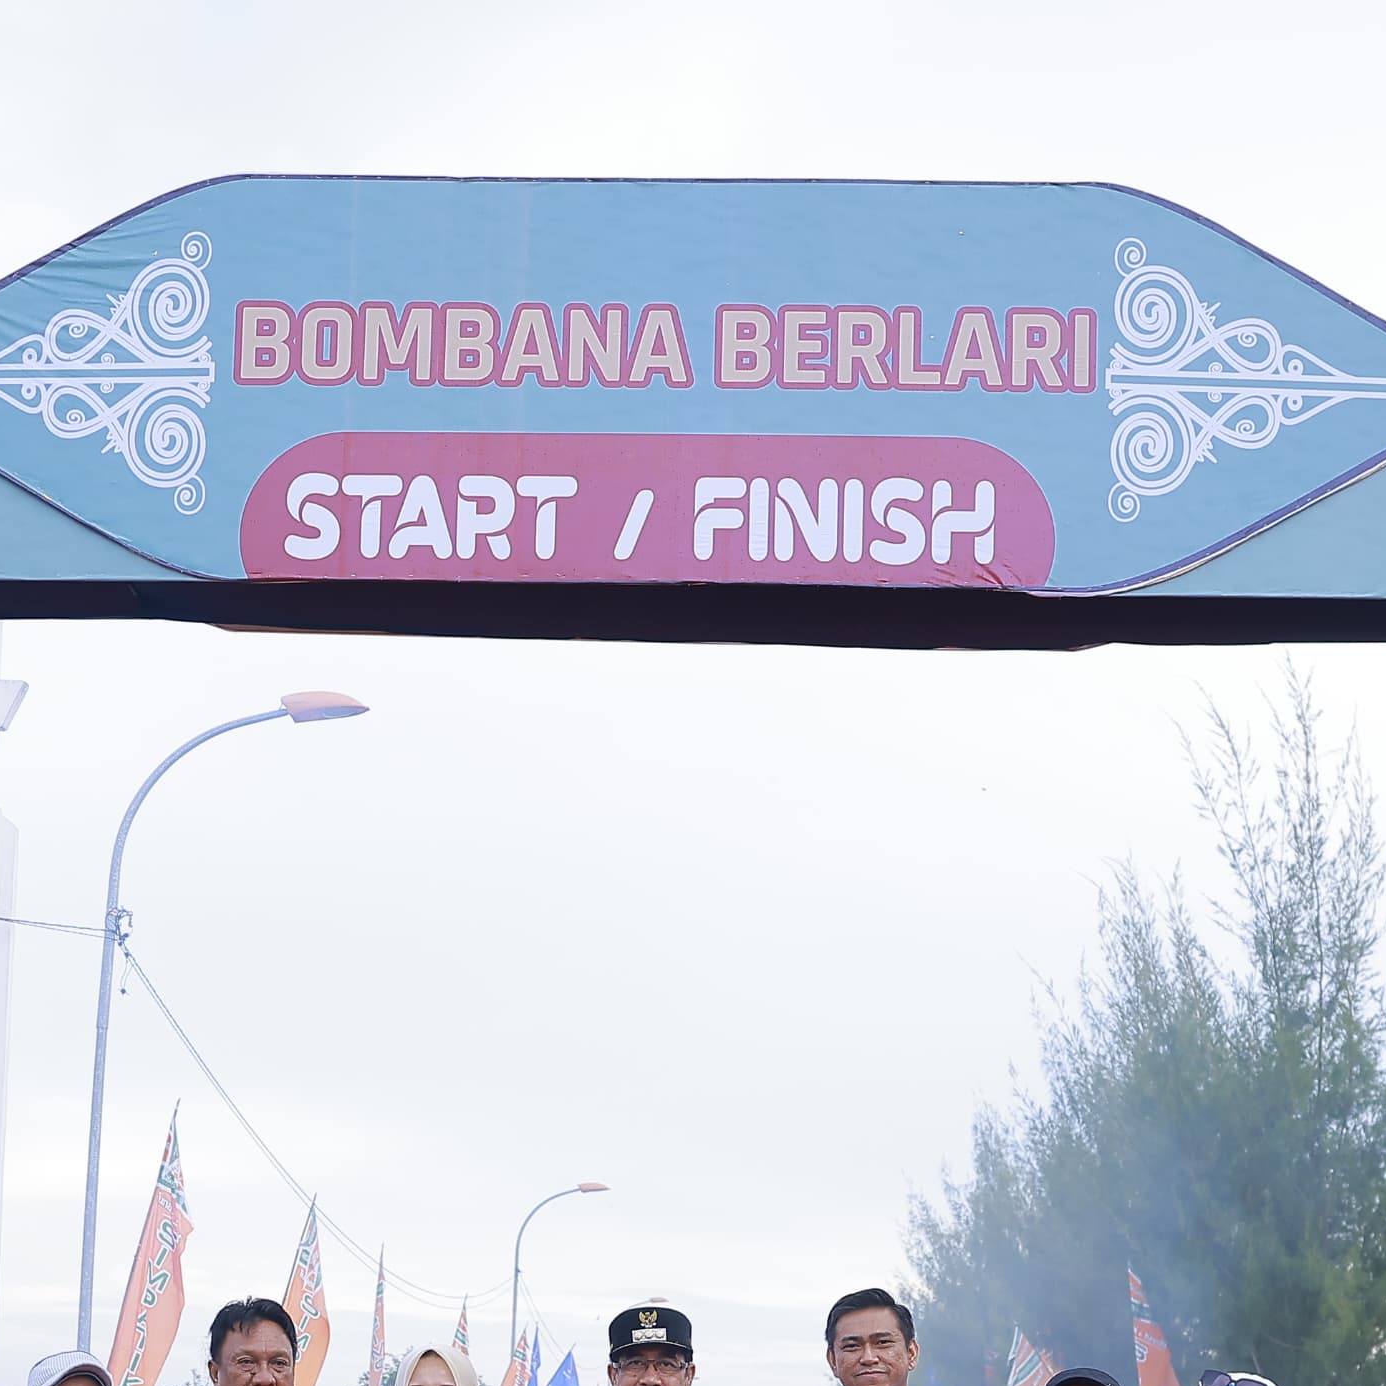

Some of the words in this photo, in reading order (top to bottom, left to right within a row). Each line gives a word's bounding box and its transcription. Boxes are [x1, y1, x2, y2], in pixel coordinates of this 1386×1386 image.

[234, 301, 693, 390] BOMBANA
[714, 305, 1096, 392] BERLARI
[283, 472, 579, 560] START
[613, 488, 655, 561] /
[693, 477, 996, 565] FINISH
